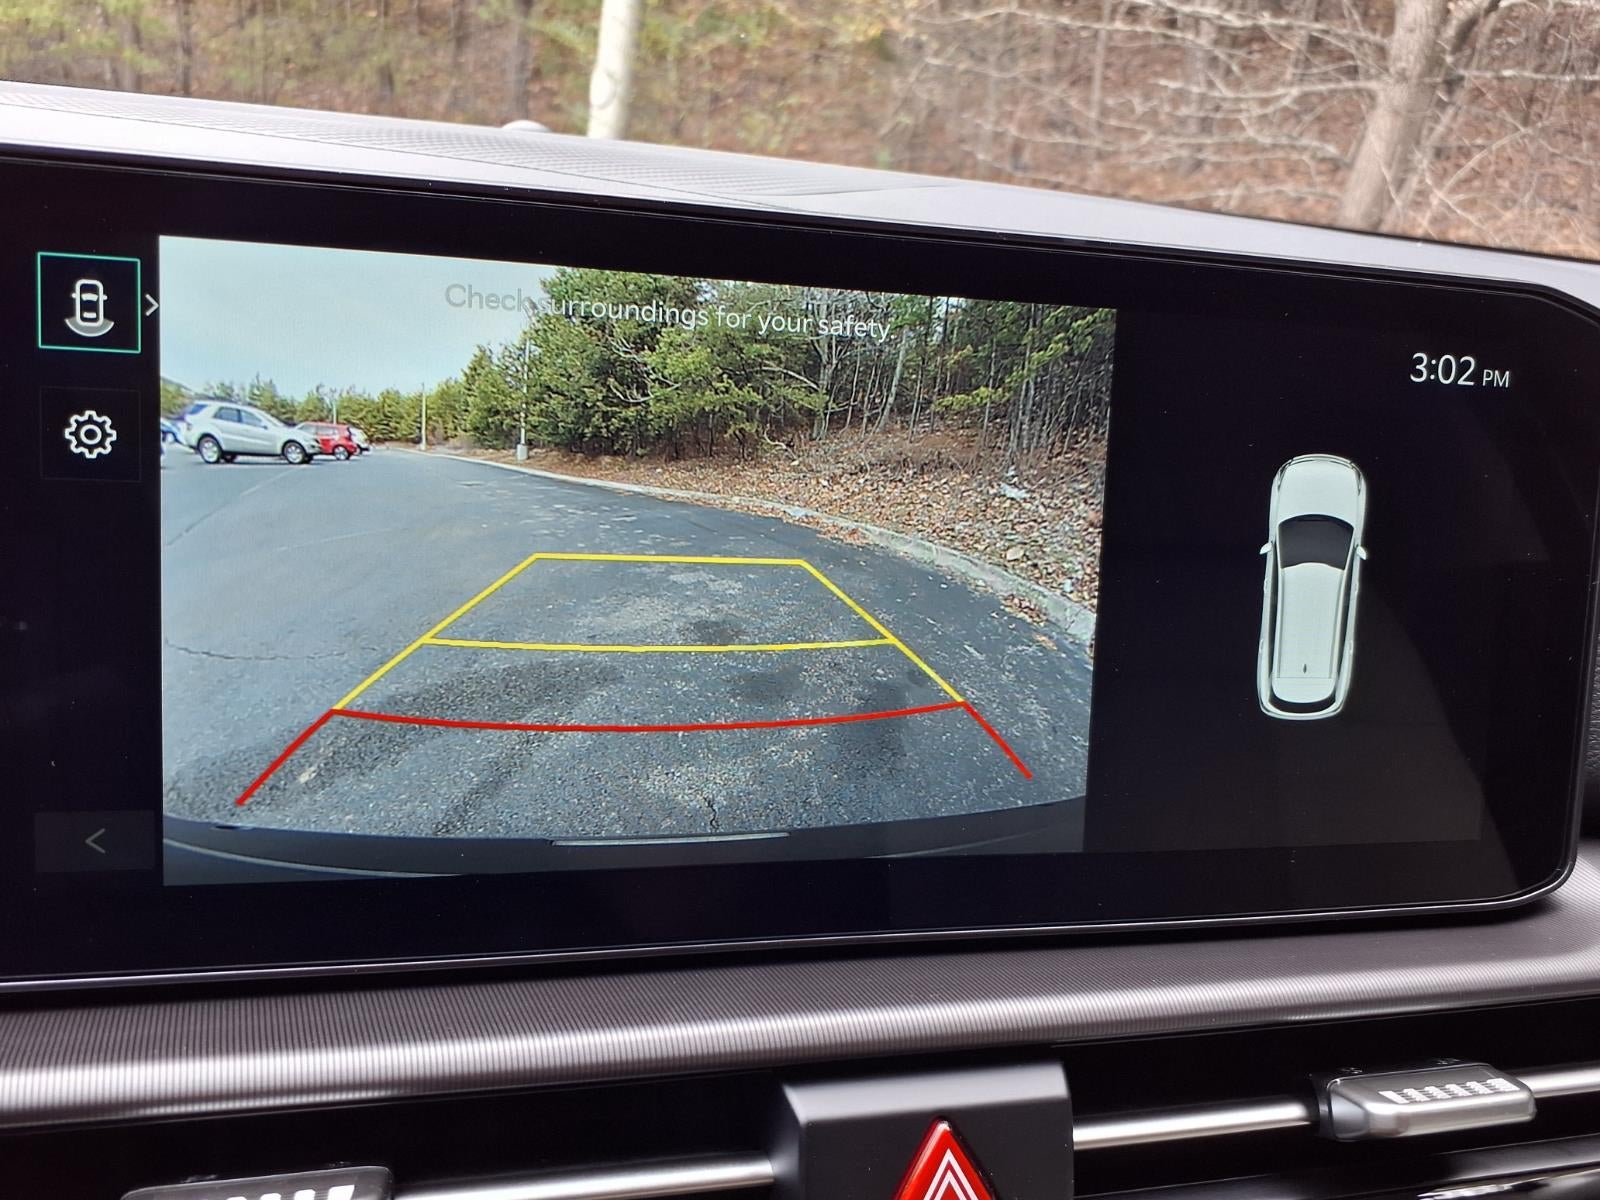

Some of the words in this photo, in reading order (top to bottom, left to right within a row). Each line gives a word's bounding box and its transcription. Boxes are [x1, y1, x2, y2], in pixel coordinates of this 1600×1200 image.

[444, 283, 533, 313] Check
[715, 305, 751, 329] for
[758, 311, 813, 335] your
[818, 314, 897, 342] safety.
[1410, 352, 1475, 386] 3:02
[1482, 369, 1510, 388] PM
